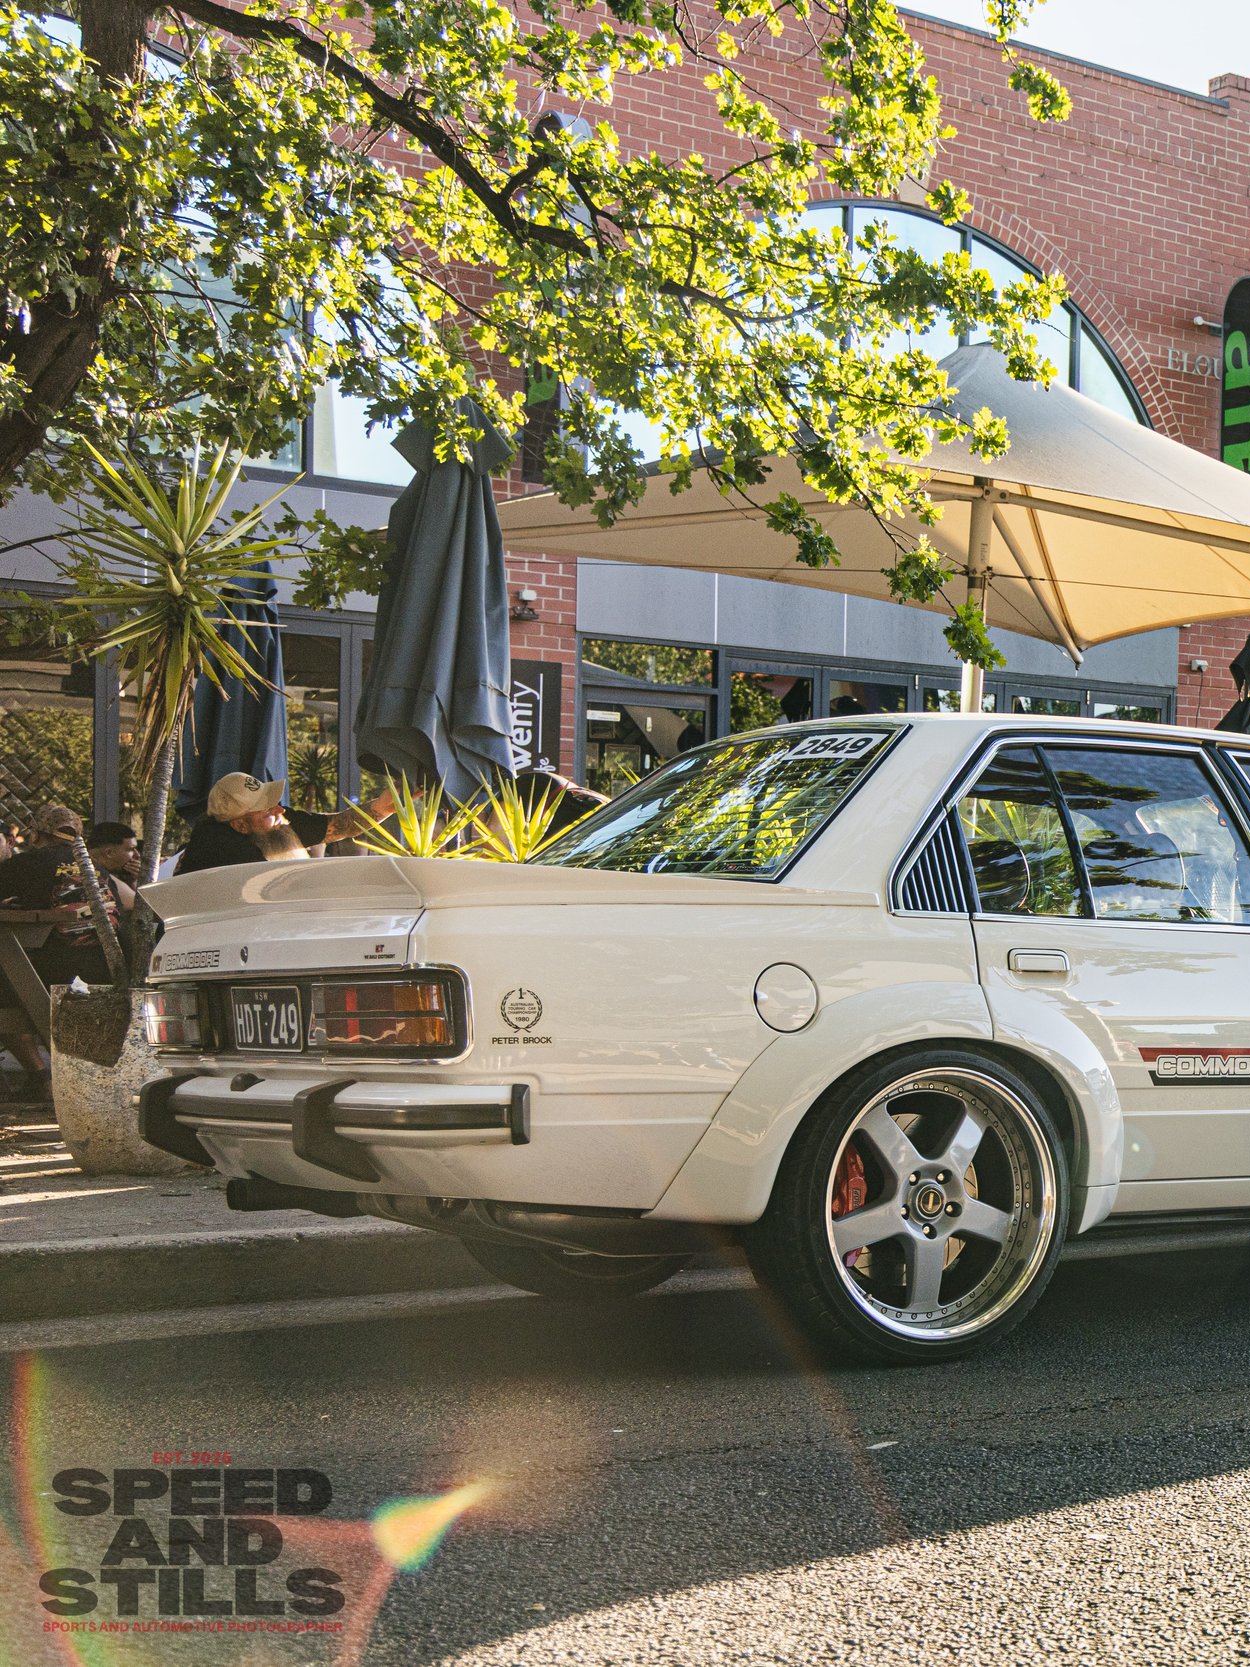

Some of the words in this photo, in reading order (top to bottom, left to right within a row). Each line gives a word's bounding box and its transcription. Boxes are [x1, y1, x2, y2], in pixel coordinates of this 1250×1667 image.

[510, 680, 541, 771] wenty
[792, 737, 874, 756] 2849
[164, 949, 220, 972] COMMODORE
[254, 991, 269, 1001] NSW
[491, 1037, 520, 1045] PETER
[522, 1036, 553, 1045] BROCK
